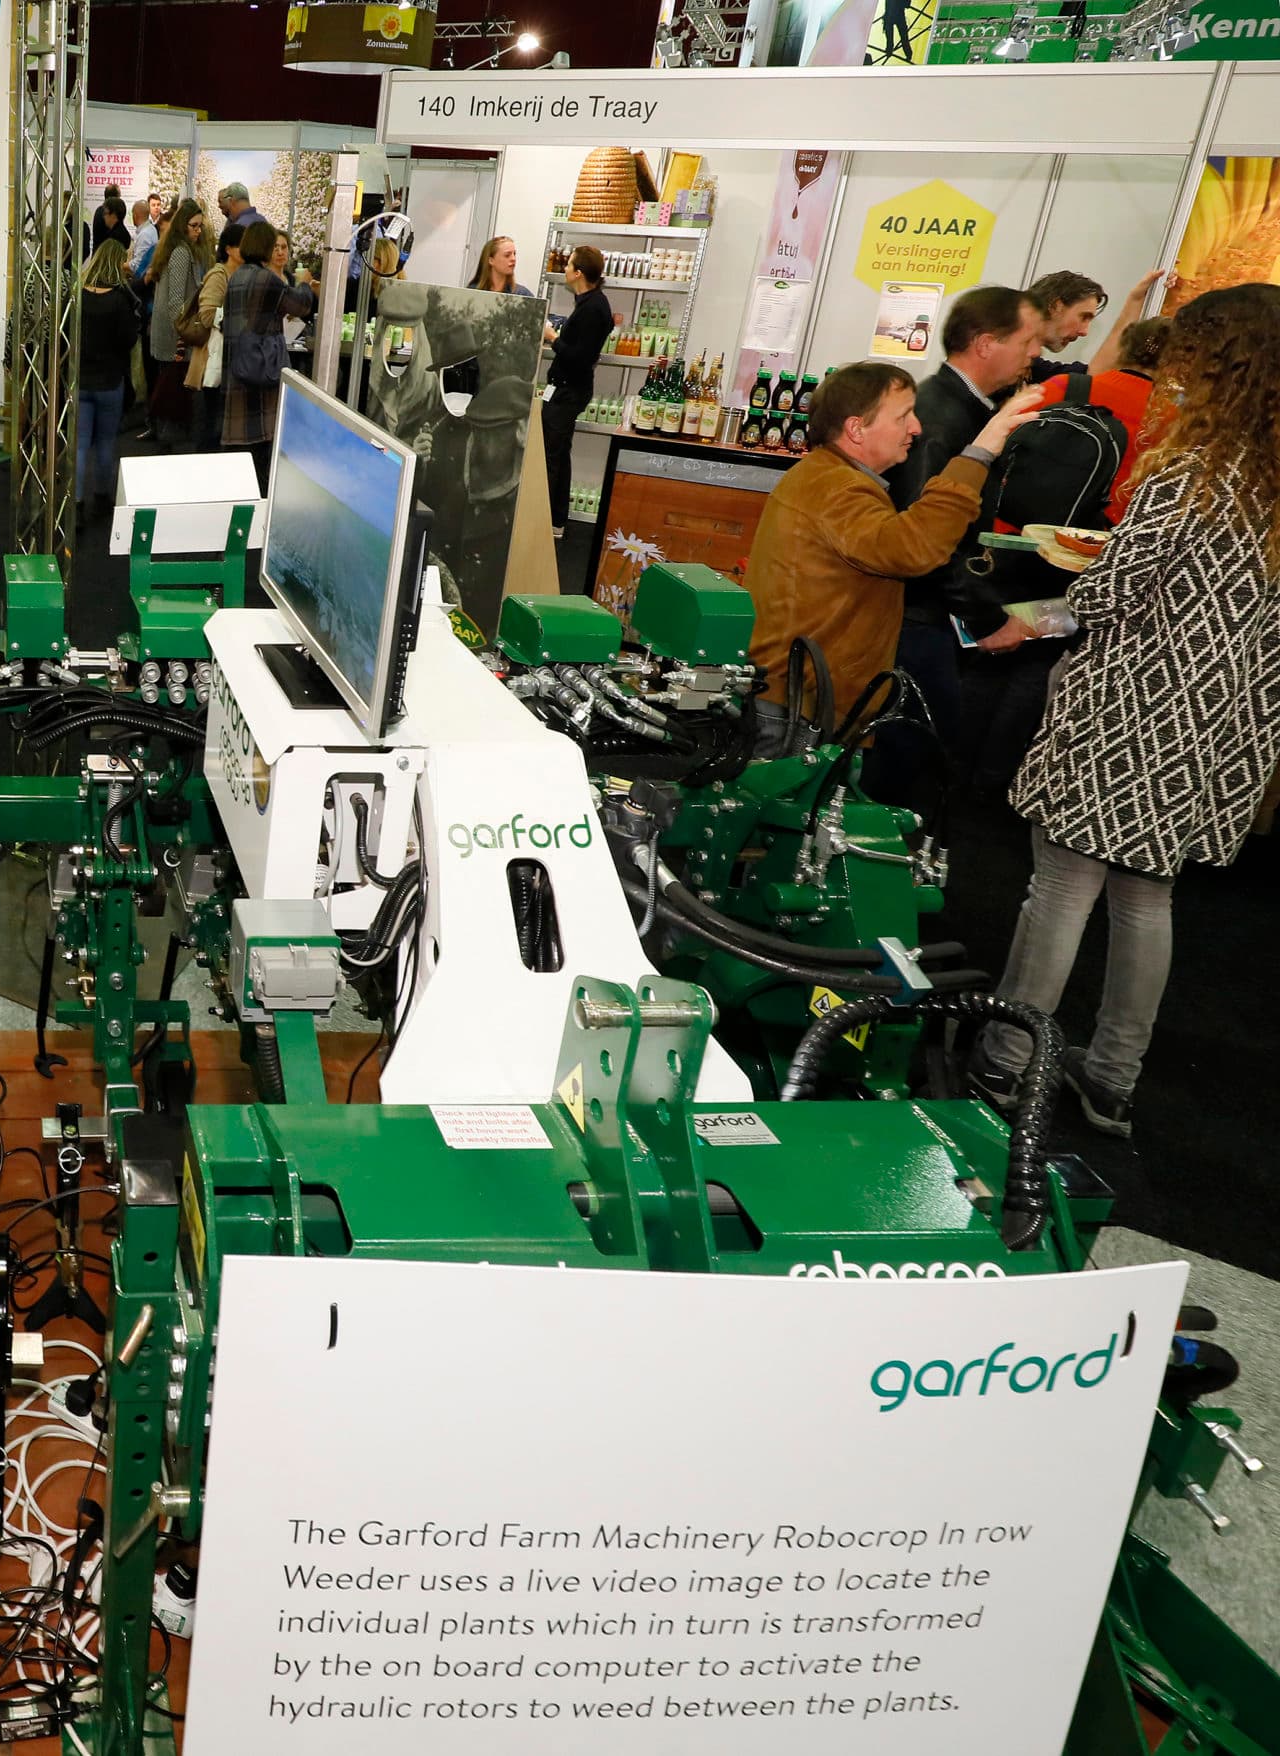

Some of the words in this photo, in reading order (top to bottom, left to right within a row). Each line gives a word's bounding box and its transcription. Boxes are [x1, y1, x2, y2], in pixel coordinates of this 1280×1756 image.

[1188, 13, 1280, 39] Kenn
[418, 96, 455, 117] 140
[470, 96, 544, 122] Imkerij
[550, 96, 579, 117] de
[589, 95, 658, 124] Traay
[87, 166, 106, 174] ALS
[109, 166, 135, 174] ZELF
[106, 155, 131, 163] FRIS
[86, 177, 134, 186] GEPLUKT
[880, 216, 907, 233] 40
[913, 217, 977, 236] JAAR
[875, 242, 972, 261] Verslingerd
[872, 260, 902, 271] aan
[906, 260, 966, 277] honing!
[452, 624, 480, 643] AAY
[447, 813, 593, 859] garford
[694, 1114, 756, 1130] garford
[870, 1333, 1118, 1412] garford
[288, 1519, 346, 1545] The
[359, 1521, 488, 1547] Garford
[500, 1523, 580, 1548] Farm
[592, 1524, 764, 1557] Machinery
[774, 1525, 928, 1553] Robocrop
[939, 1522, 964, 1544] In
[975, 1525, 1032, 1543] row
[284, 1565, 411, 1590] Weeder
[420, 1575, 487, 1592] uses
[499, 1576, 514, 1592] a
[528, 1569, 580, 1592] live
[592, 1569, 677, 1592] video
[688, 1570, 783, 1599] image
[794, 1571, 825, 1591] to
[836, 1568, 931, 1590] locate
[942, 1564, 990, 1587] the
[279, 1609, 429, 1634] individual
[440, 1611, 534, 1642] plants
[547, 1612, 636, 1635] which
[648, 1613, 674, 1635] in
[686, 1615, 749, 1635] turn
[761, 1612, 782, 1634] is
[793, 1605, 984, 1633] transformed
[274, 1652, 311, 1683] by
[320, 1653, 372, 1676] the
[383, 1661, 420, 1677] on
[433, 1654, 524, 1677] board
[535, 1657, 690, 1684] computer
[698, 1657, 729, 1676] to
[740, 1653, 862, 1676] activate
[872, 1650, 921, 1672] the
[269, 1694, 412, 1724] hydraulic
[424, 1699, 518, 1718] rotors
[529, 1699, 560, 1718] to
[573, 1696, 654, 1718] weed
[664, 1696, 795, 1717] between
[806, 1693, 855, 1715] the
[863, 1691, 959, 1720] plants.
